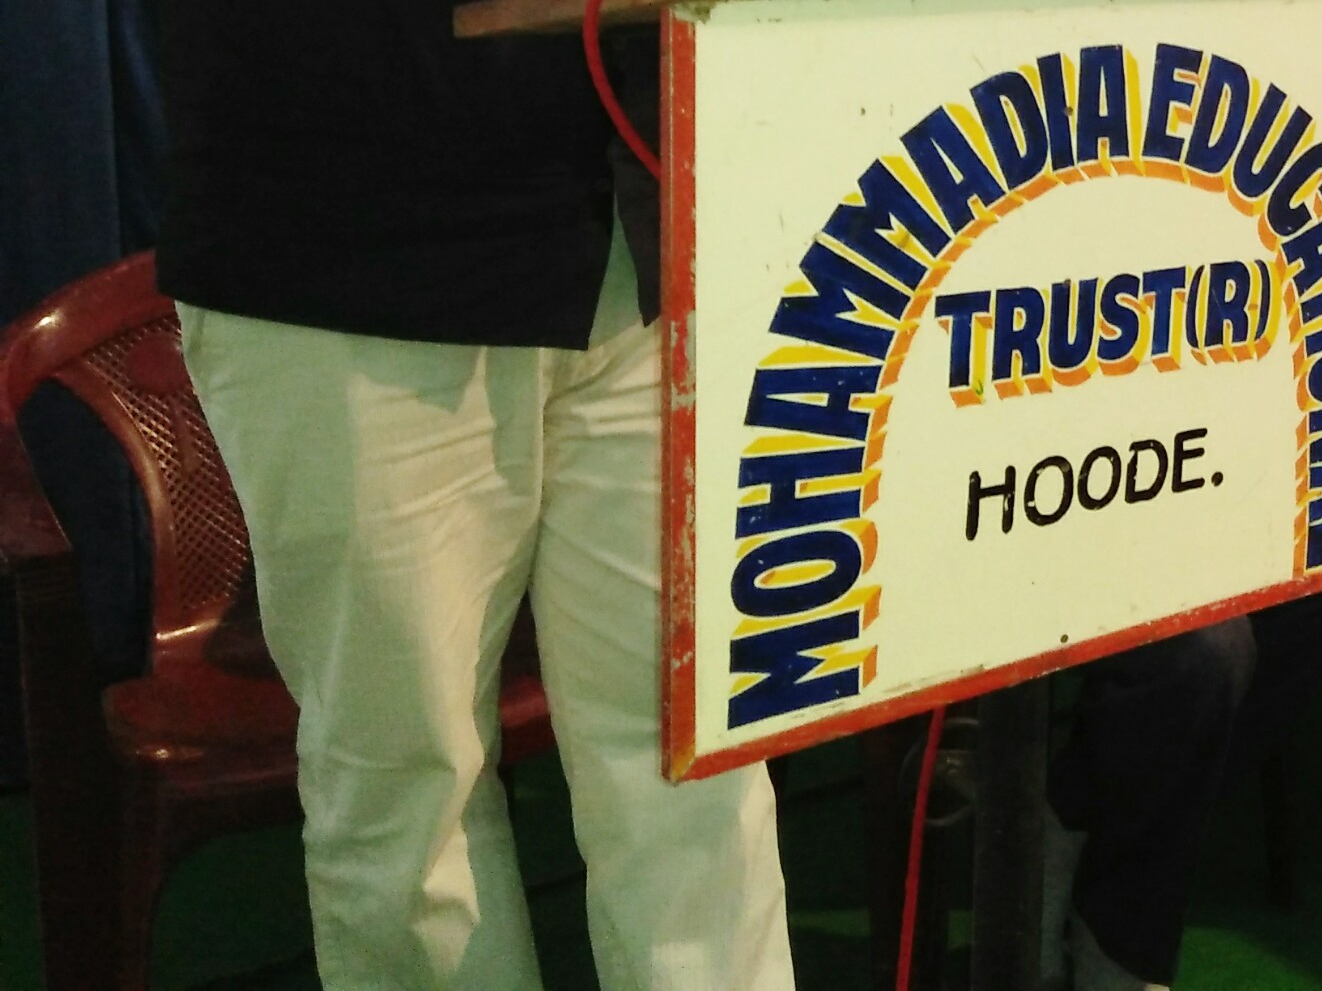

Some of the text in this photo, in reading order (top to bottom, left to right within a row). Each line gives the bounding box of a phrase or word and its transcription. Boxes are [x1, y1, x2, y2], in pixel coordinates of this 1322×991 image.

[727, 43, 1134, 731] MOHAMMADIA
[934, 259, 1274, 397] TRUST(R)
[964, 427, 1224, 541] HOODE.
